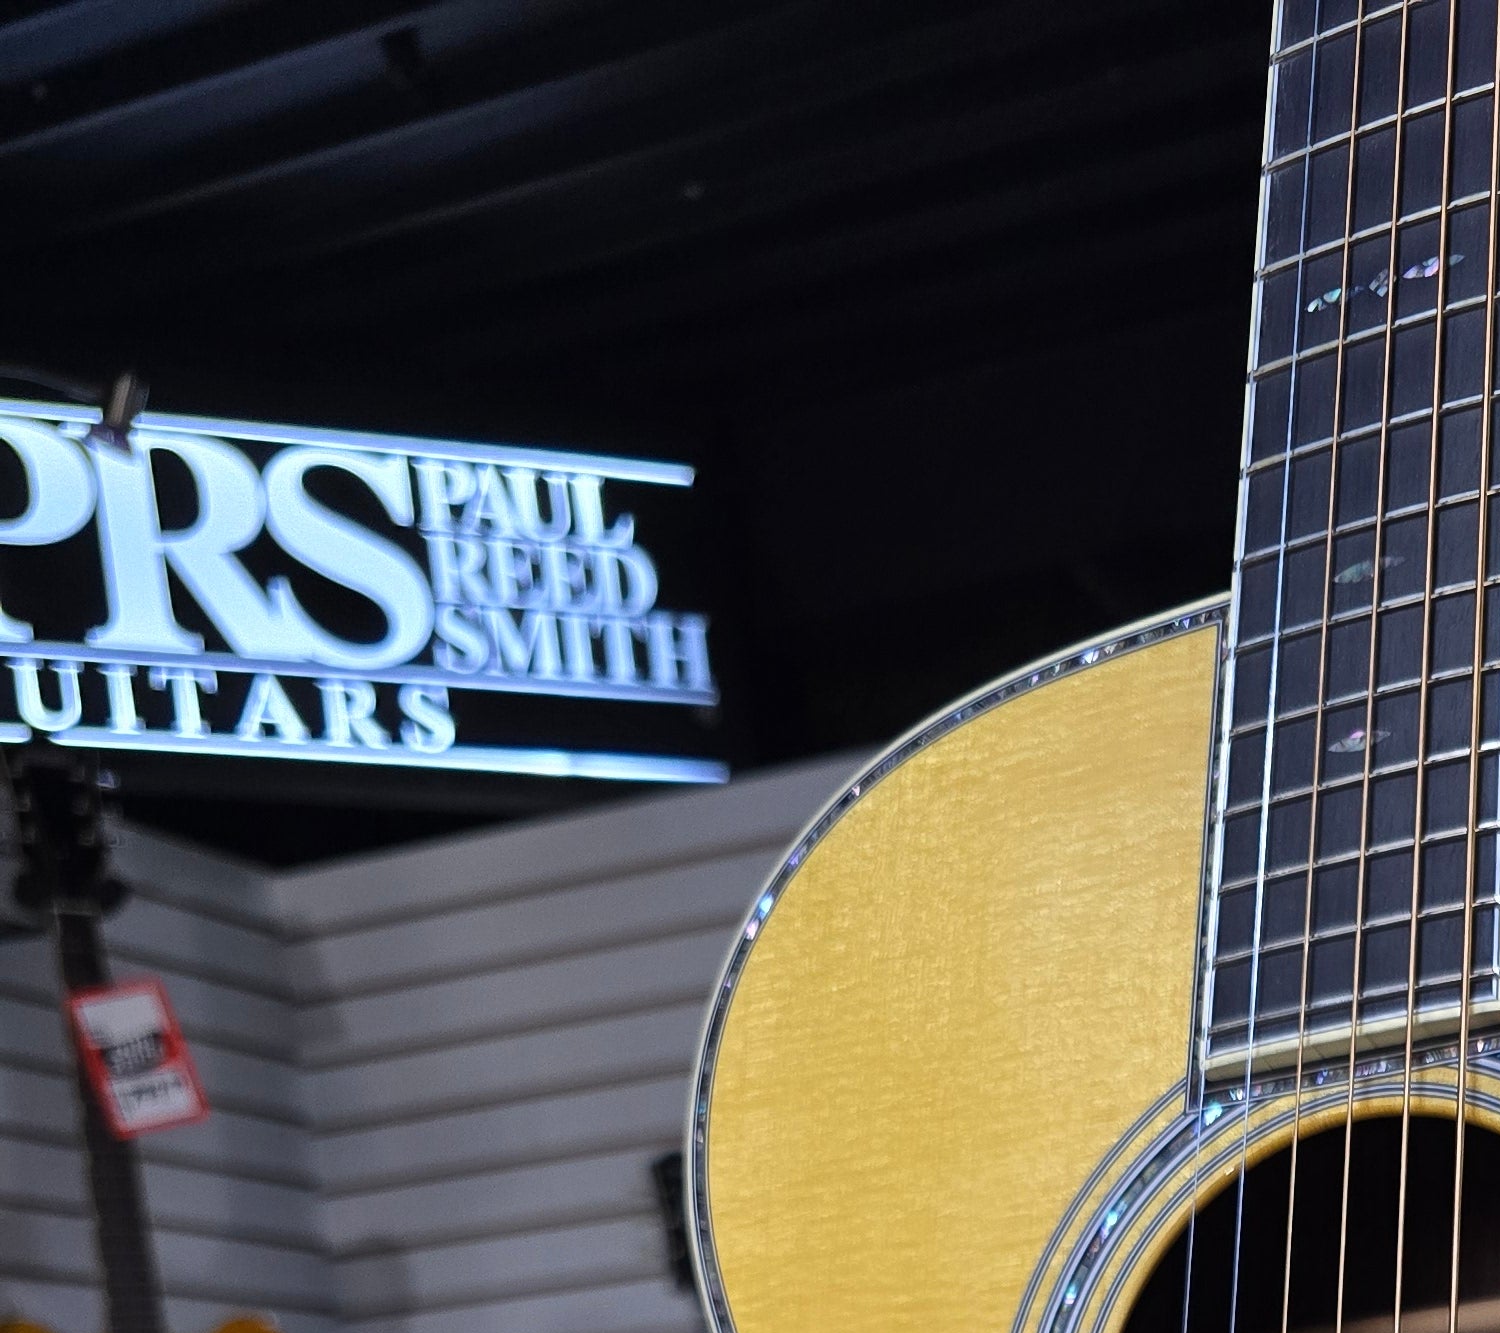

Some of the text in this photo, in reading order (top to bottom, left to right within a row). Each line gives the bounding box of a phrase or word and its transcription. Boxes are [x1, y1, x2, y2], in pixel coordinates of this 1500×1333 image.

[0, 417, 434, 670] PRS
[411, 460, 635, 548] PAUL
[420, 533, 659, 618] REED
[433, 604, 712, 690] SMITH
[5, 657, 456, 753] UITARS
